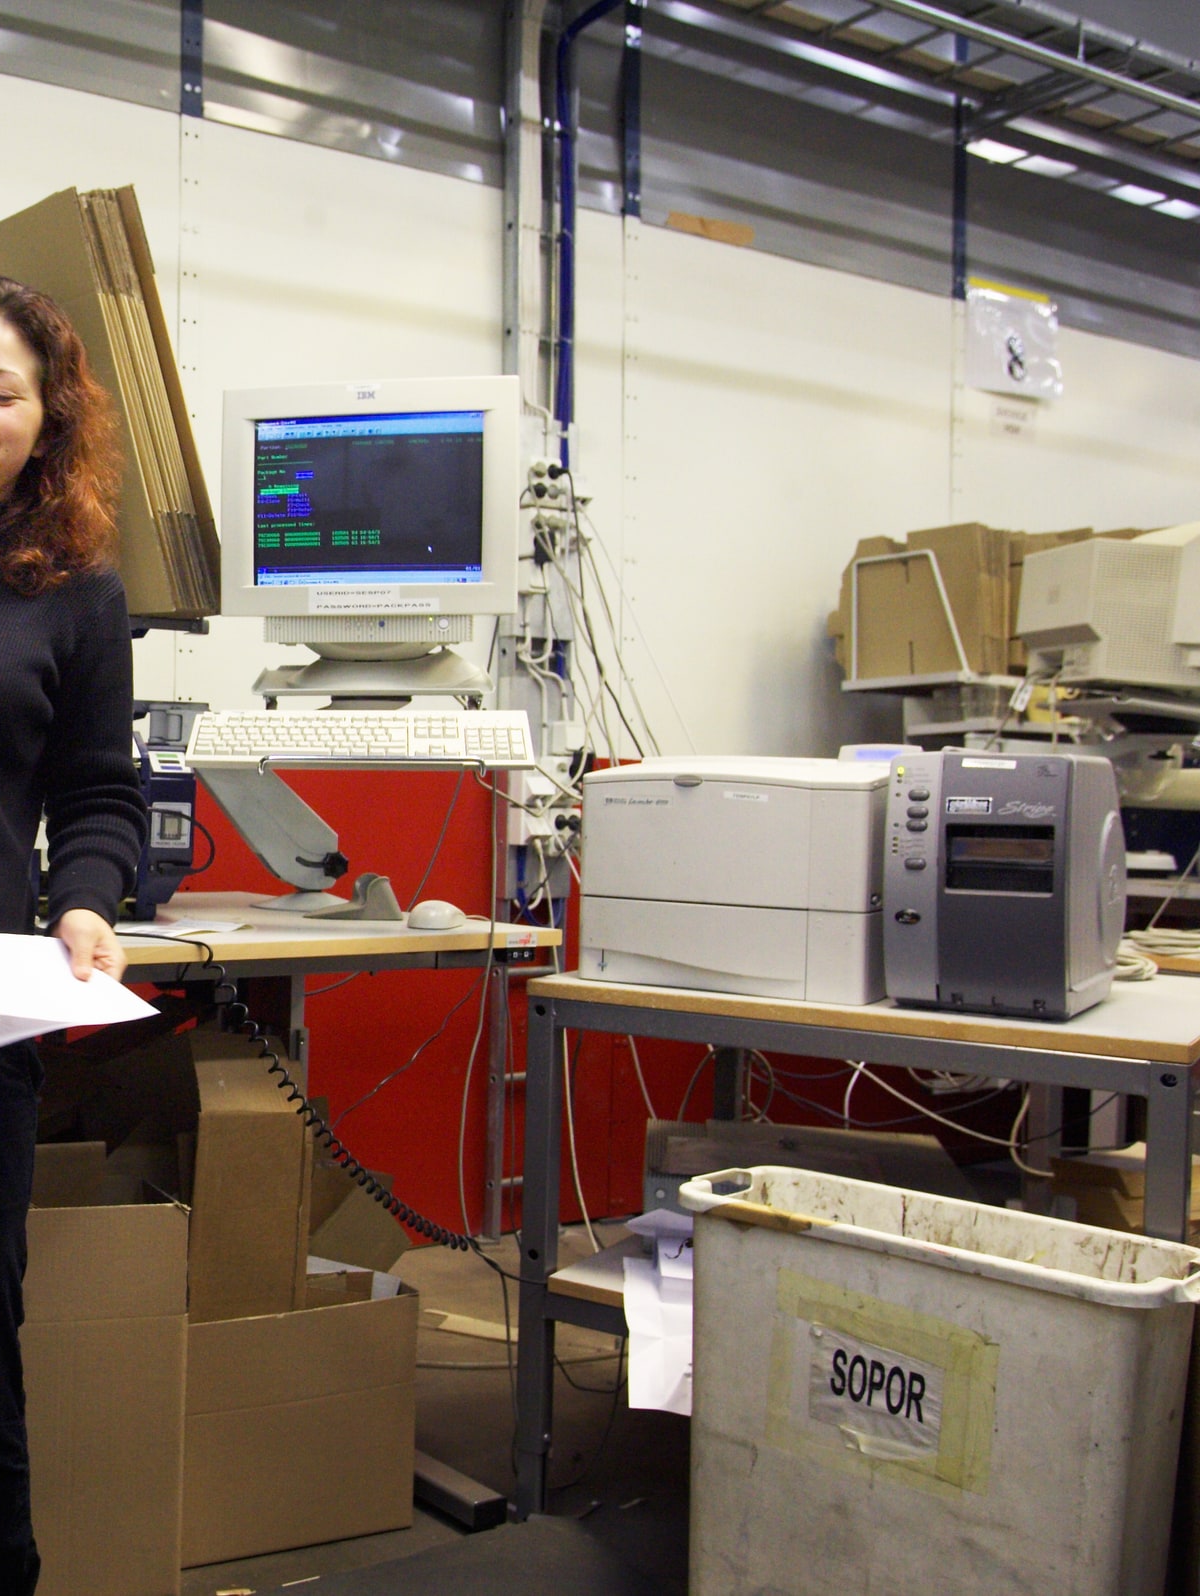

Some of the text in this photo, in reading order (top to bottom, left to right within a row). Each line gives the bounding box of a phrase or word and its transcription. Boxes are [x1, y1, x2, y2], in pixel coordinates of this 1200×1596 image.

[1006, 335, 1028, 382] 8
[357, 391, 376, 400] IBM
[997, 800, 1054, 819] Stripe
[830, 1347, 927, 1423] SOPOR
